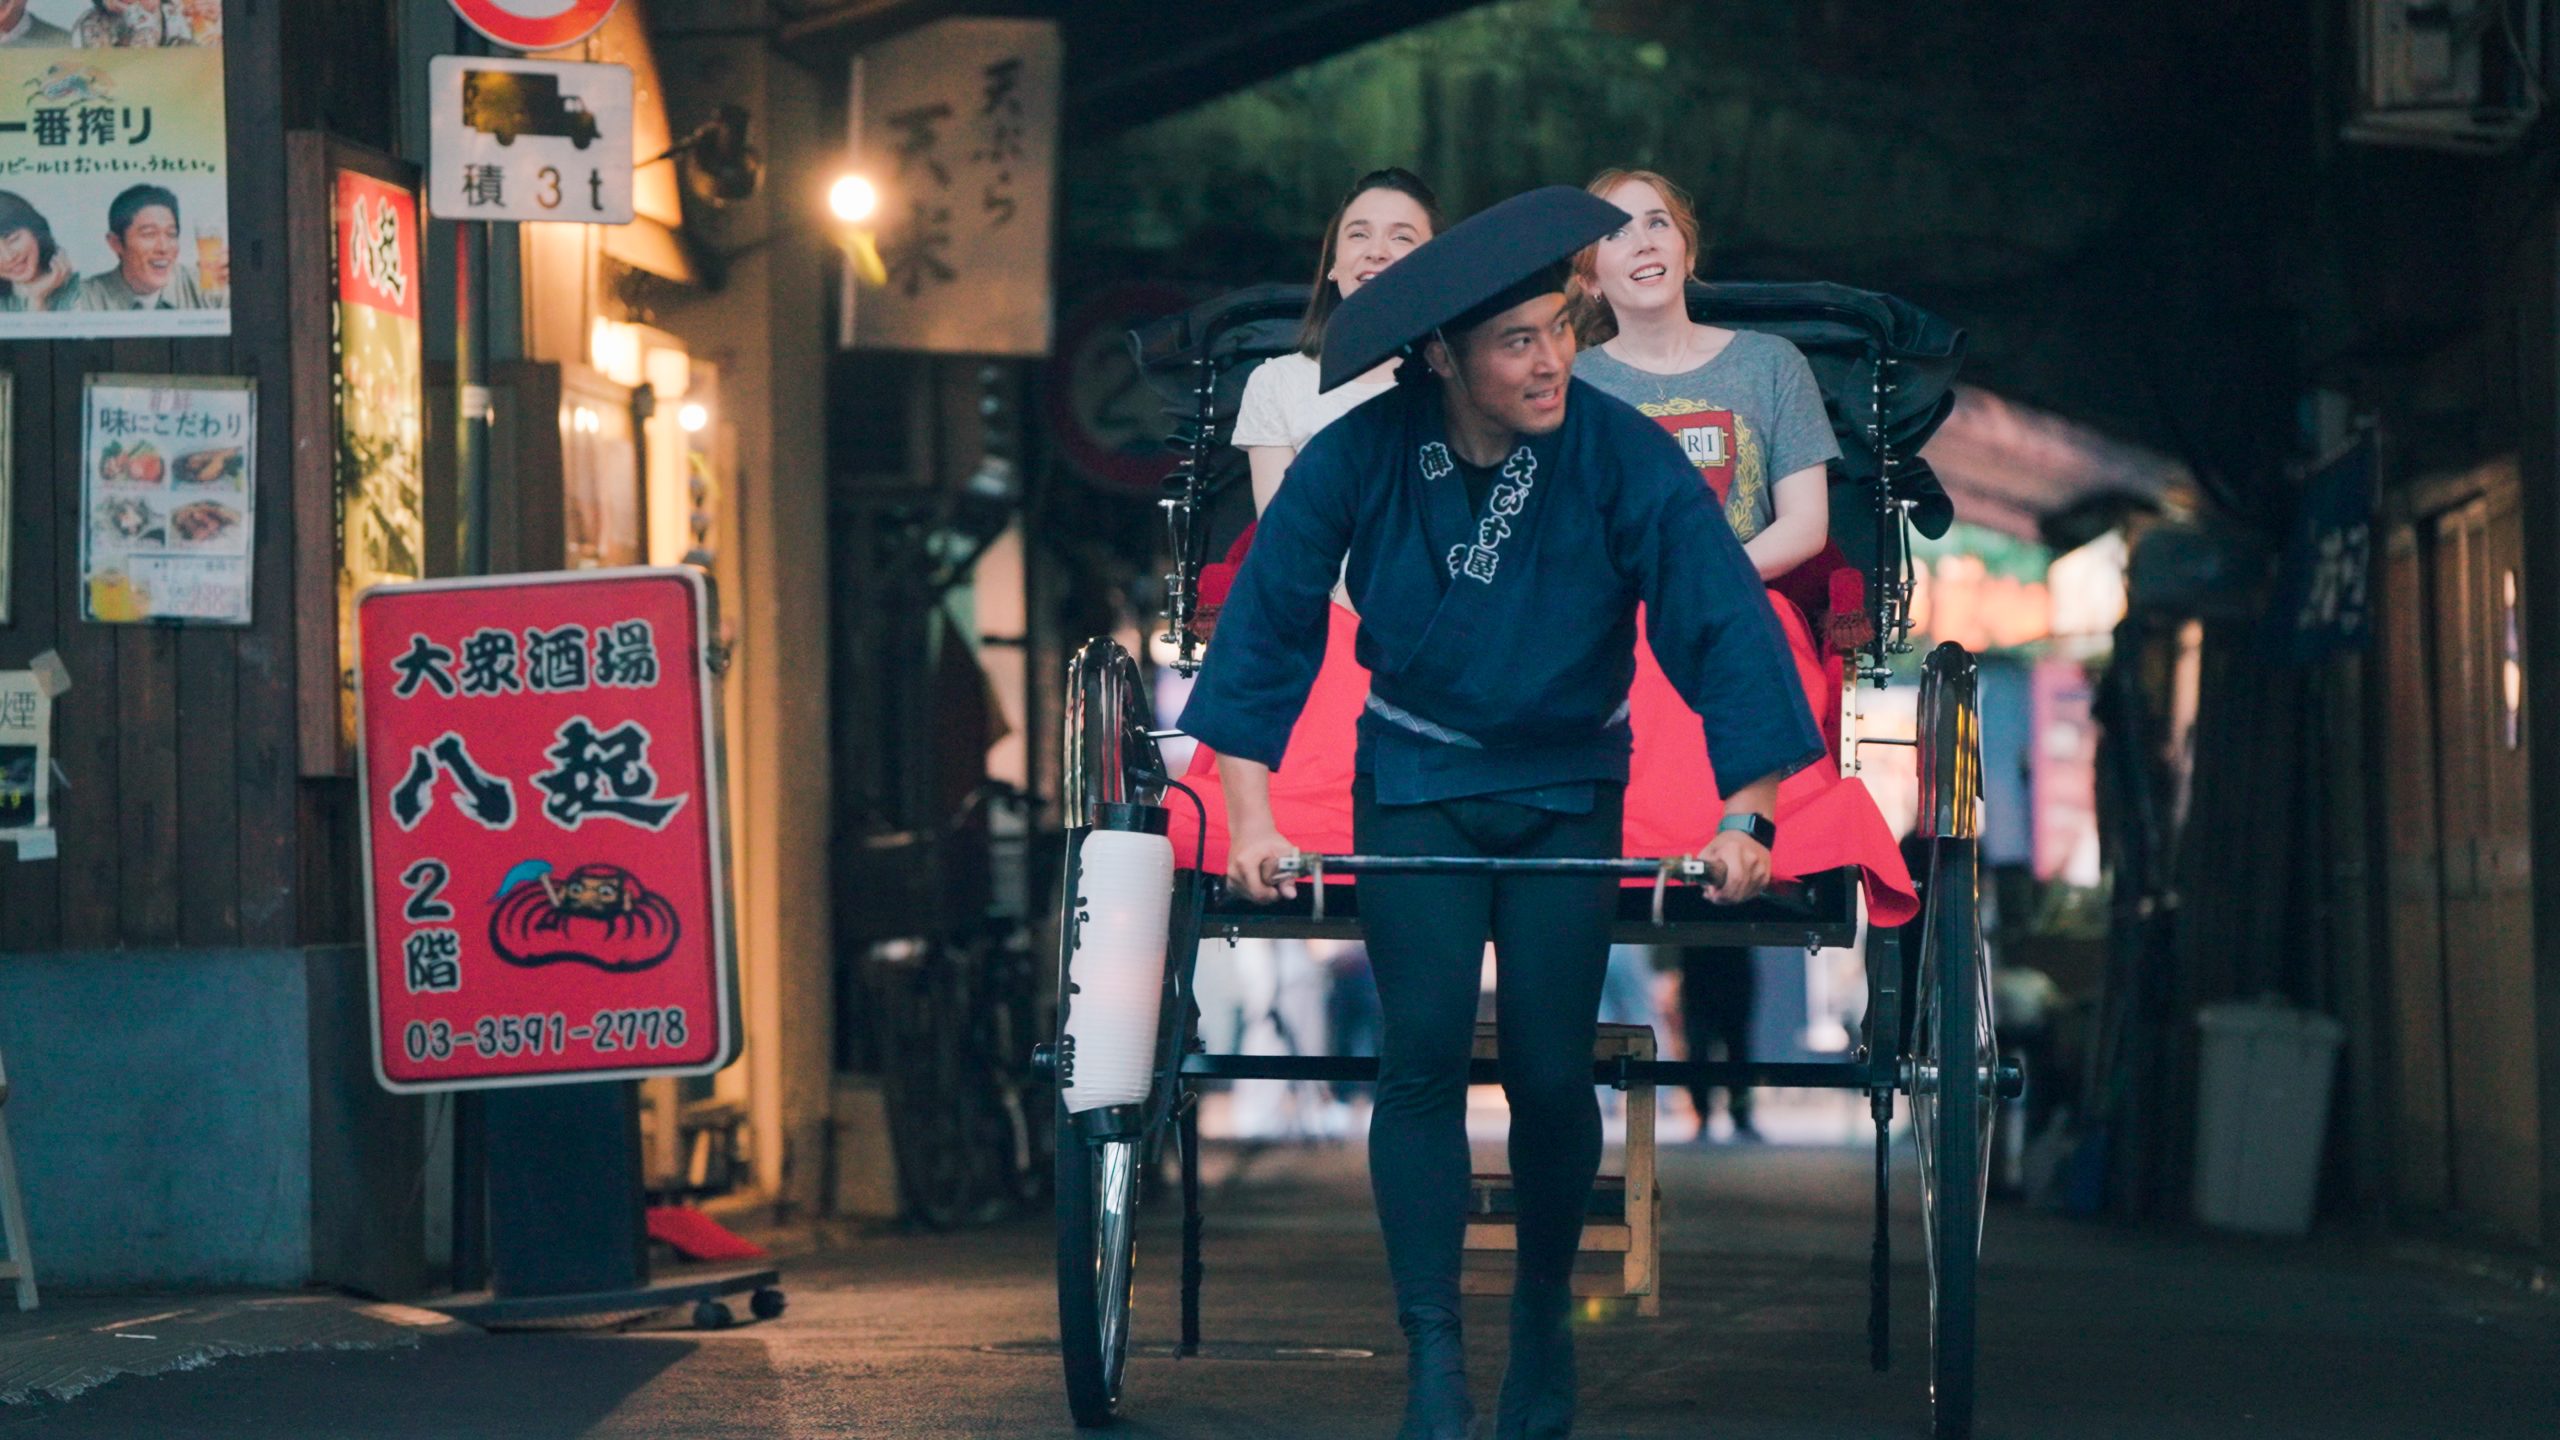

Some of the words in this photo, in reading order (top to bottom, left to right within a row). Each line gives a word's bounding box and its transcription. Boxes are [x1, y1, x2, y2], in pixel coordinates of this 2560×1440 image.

[0, 106, 151, 147] 一番搾り
[101, 407, 242, 438] 味にこだわり
[1464, 446, 1538, 584] えびす屋
[391, 618, 659, 699] 大衆酒場
[390, 715, 690, 830] 八起
[401, 858, 460, 993] 2階
[404, 1005, 688, 1063] 03-3591-2778
